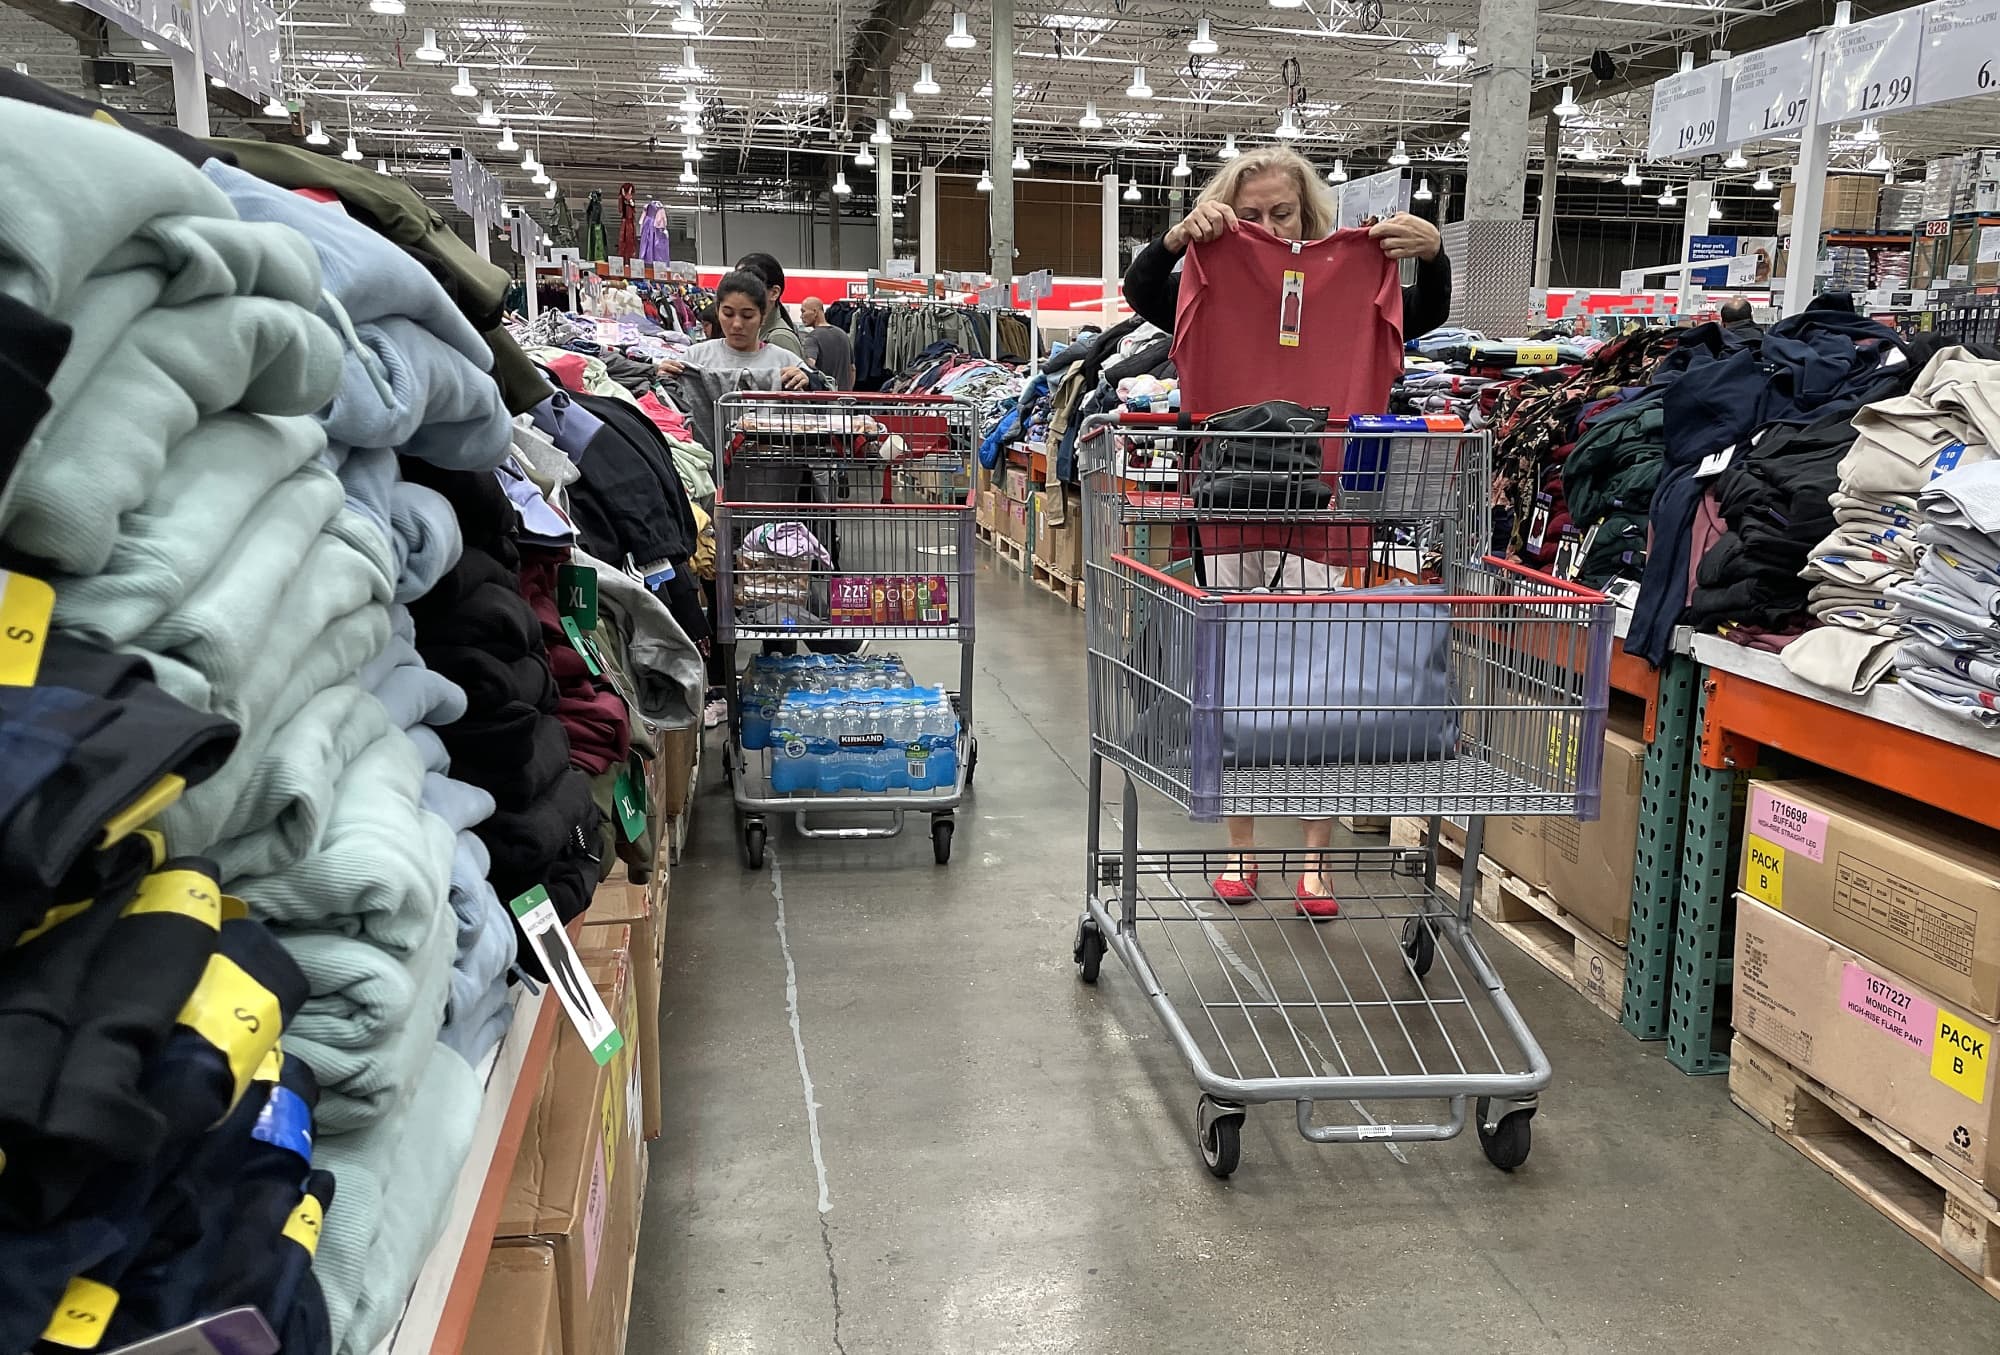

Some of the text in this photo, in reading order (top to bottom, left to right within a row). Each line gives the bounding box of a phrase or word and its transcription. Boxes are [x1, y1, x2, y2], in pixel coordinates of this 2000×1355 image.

[1977, 59, 2000, 89] 6.
[1860, 76, 1912, 112] 12.99
[1678, 119, 1715, 149] 19.99
[1927, 221, 1947, 235] 328
[568, 586, 588, 609] XL
[6, 626, 34, 644] S
[621, 795, 636, 820] XL
[1771, 800, 1808, 824] 1716698
[1773, 815, 1802, 833] BUFFALO
[1781, 828, 1805, 843] STRAIGHT
[1806, 839, 1817, 849] LEG
[1751, 848, 1780, 874] PACK
[1760, 874, 1768, 889] B
[187, 888, 217, 908] S
[1866, 977, 1912, 1010] 1677227
[234, 1007, 261, 1035] S
[1865, 996, 1908, 1025] MONDETTA
[1848, 1001, 1924, 1047] HIGH-RISE FLARE PANT
[1940, 1023, 1985, 1060] PACK
[1953, 1057, 1964, 1075] B
[300, 1213, 318, 1235] S
[66, 1308, 97, 1324] S
